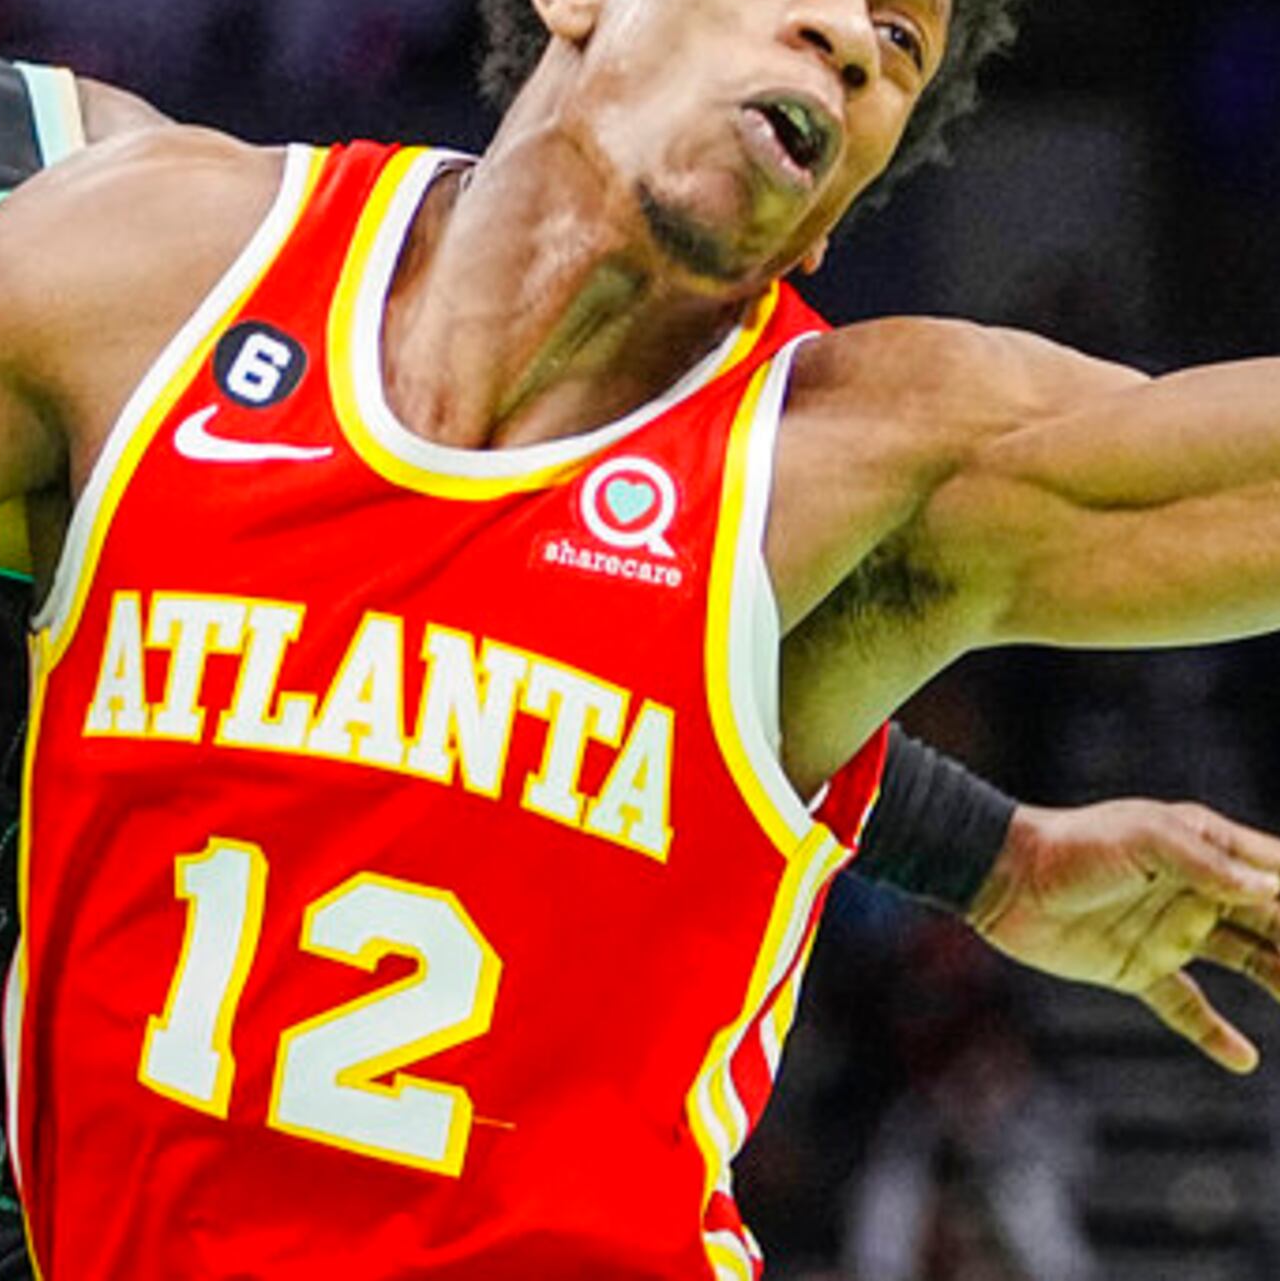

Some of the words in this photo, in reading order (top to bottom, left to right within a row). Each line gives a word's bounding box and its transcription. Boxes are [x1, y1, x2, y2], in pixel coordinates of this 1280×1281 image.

[226, 333, 290, 403] 6
[544, 538, 683, 586] sharecare
[81, 590, 678, 865] ATLANTA
[136, 834, 504, 1178] 12
